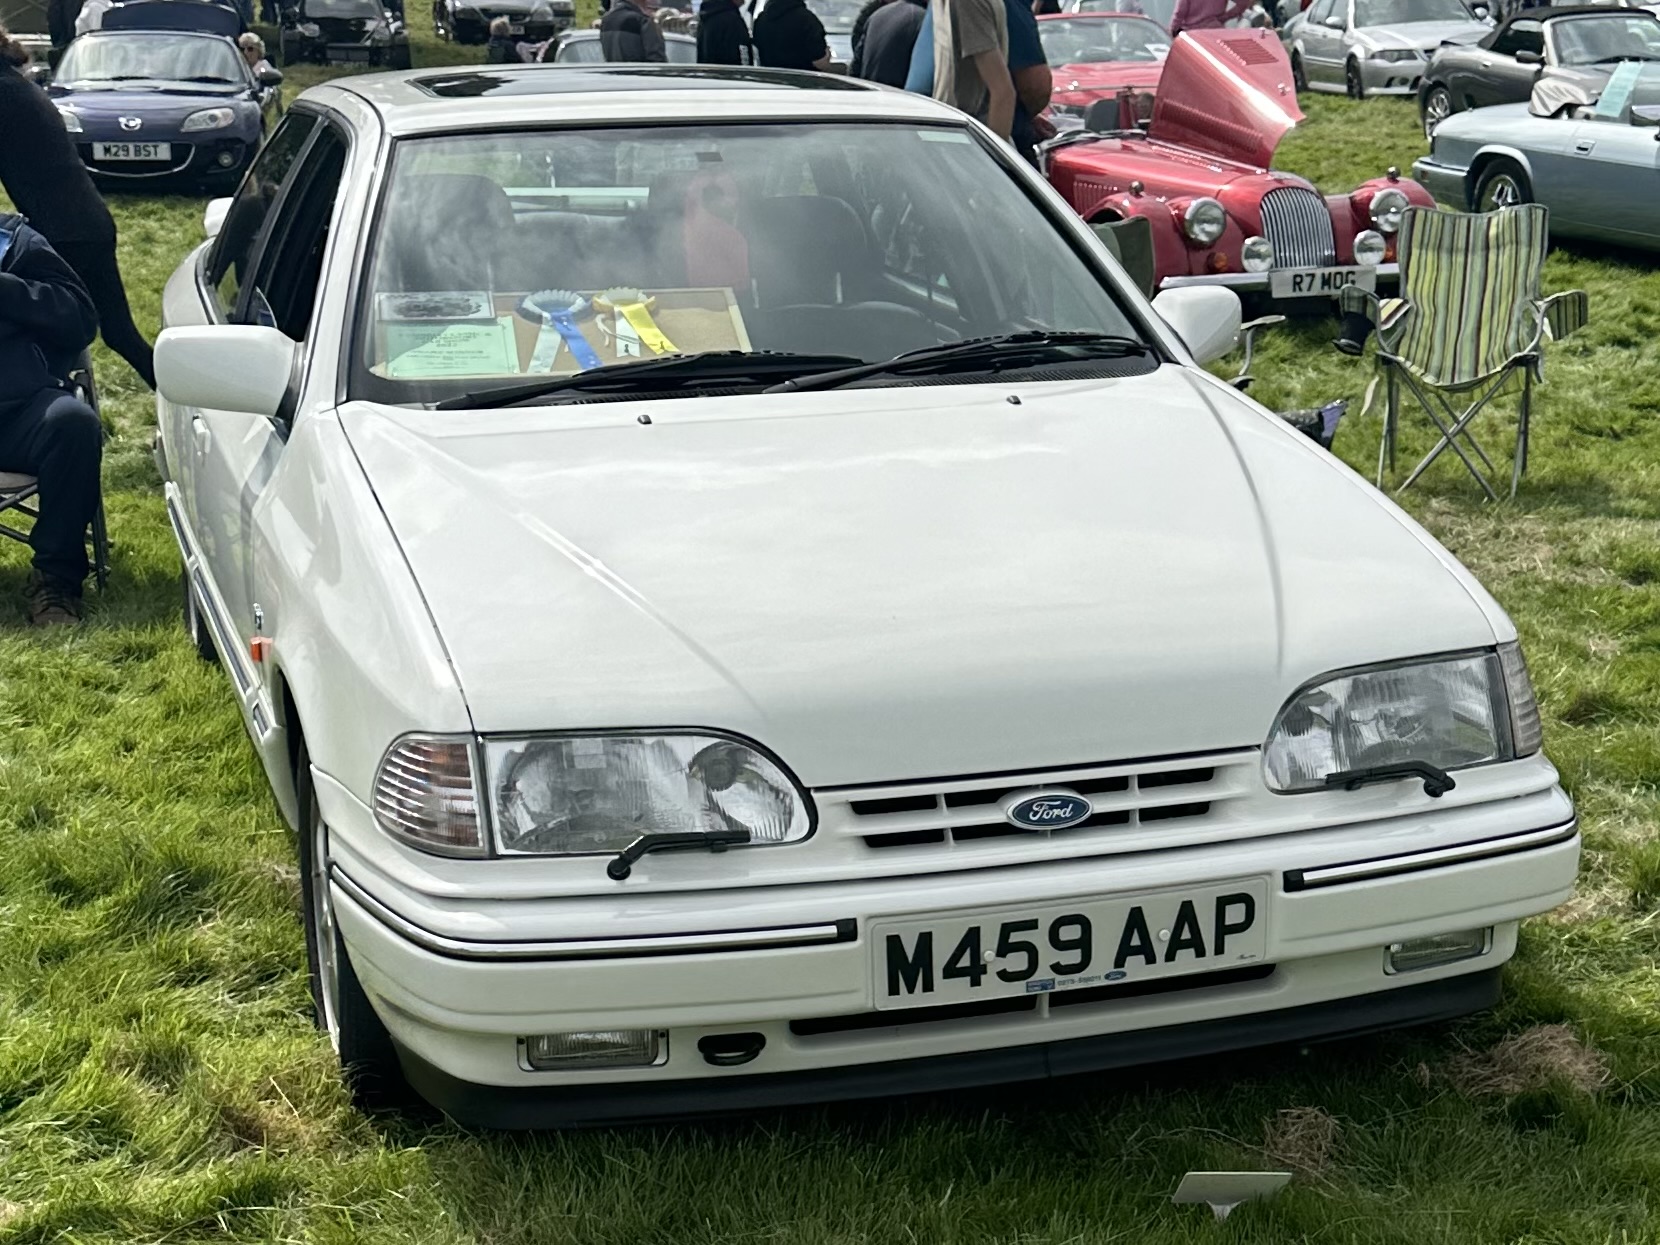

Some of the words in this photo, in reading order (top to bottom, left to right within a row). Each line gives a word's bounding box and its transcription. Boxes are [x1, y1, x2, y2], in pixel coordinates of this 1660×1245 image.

[133, 144, 160, 158] BST
[1292, 273, 1316, 293] R7
[1321, 270, 1356, 291] MOG
[1029, 800, 1074, 821] Ford
[885, 913, 1093, 997] M459
[1113, 891, 1256, 970] AAP
